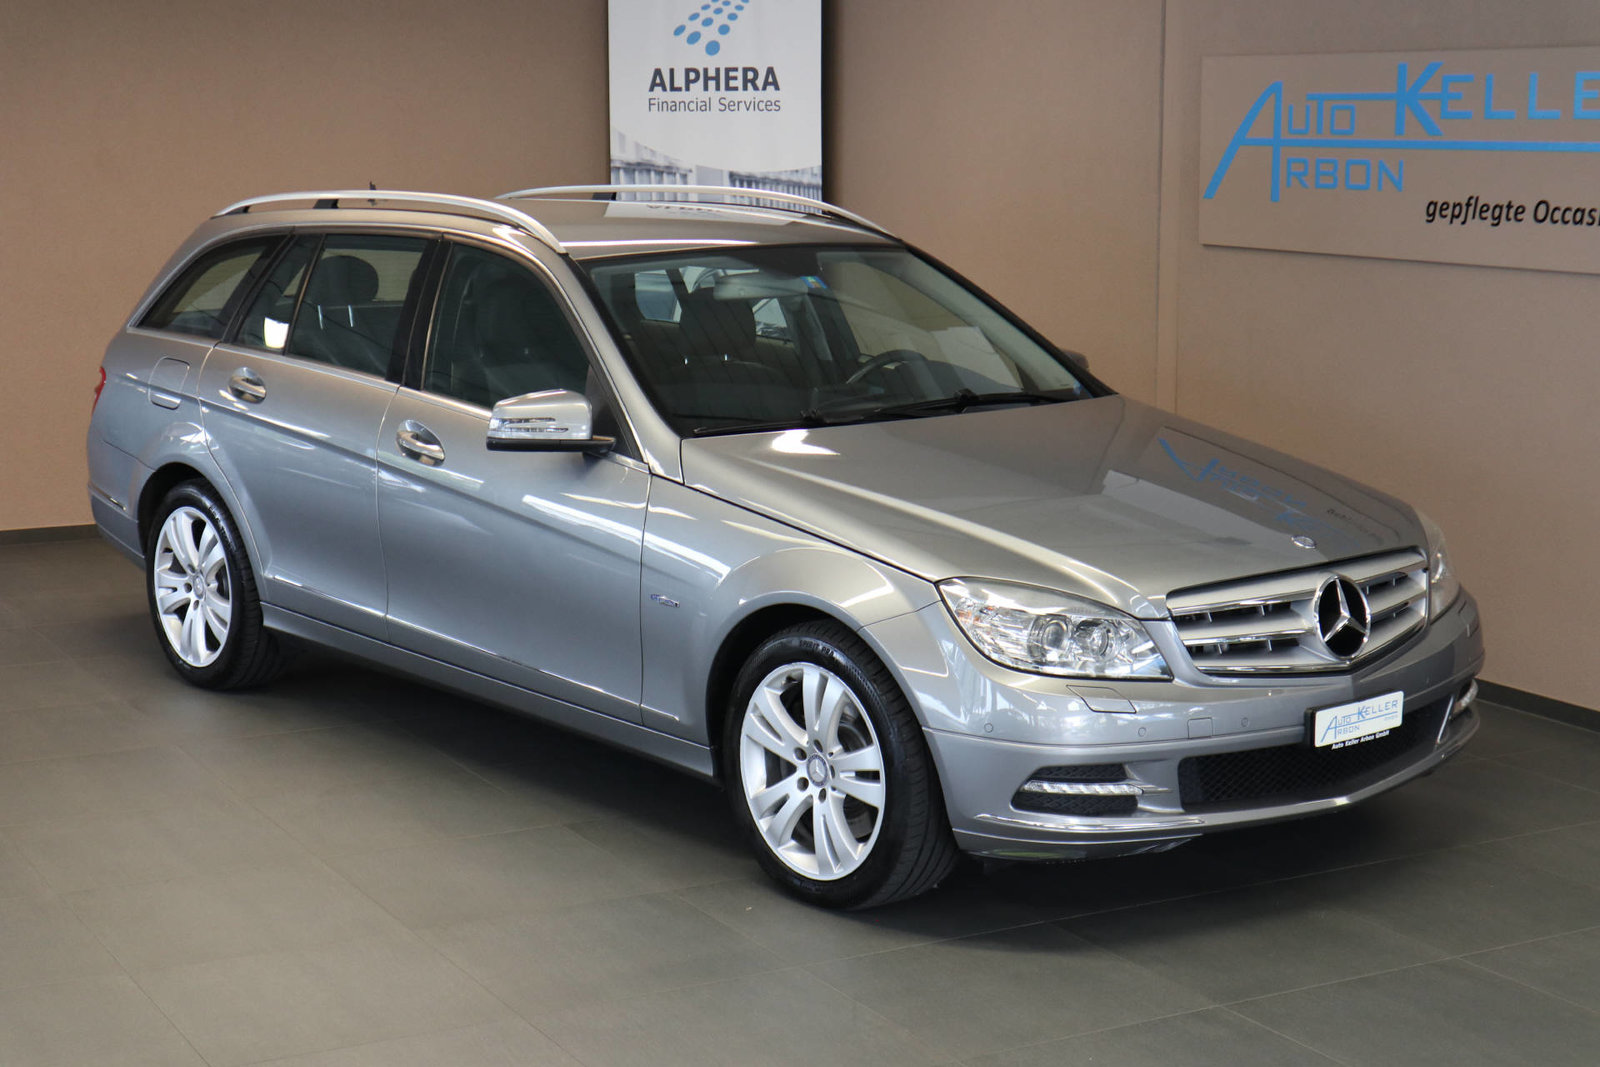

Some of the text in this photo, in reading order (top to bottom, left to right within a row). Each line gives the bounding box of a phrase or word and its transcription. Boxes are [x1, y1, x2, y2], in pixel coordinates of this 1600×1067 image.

[648, 66, 780, 92] ALPHERA
[648, 97, 781, 112] Financial Services
[1425, 195, 1526, 227] gepflegte
[1358, 700, 1398, 720] KELLER
[1331, 742, 1344, 750] Auto
